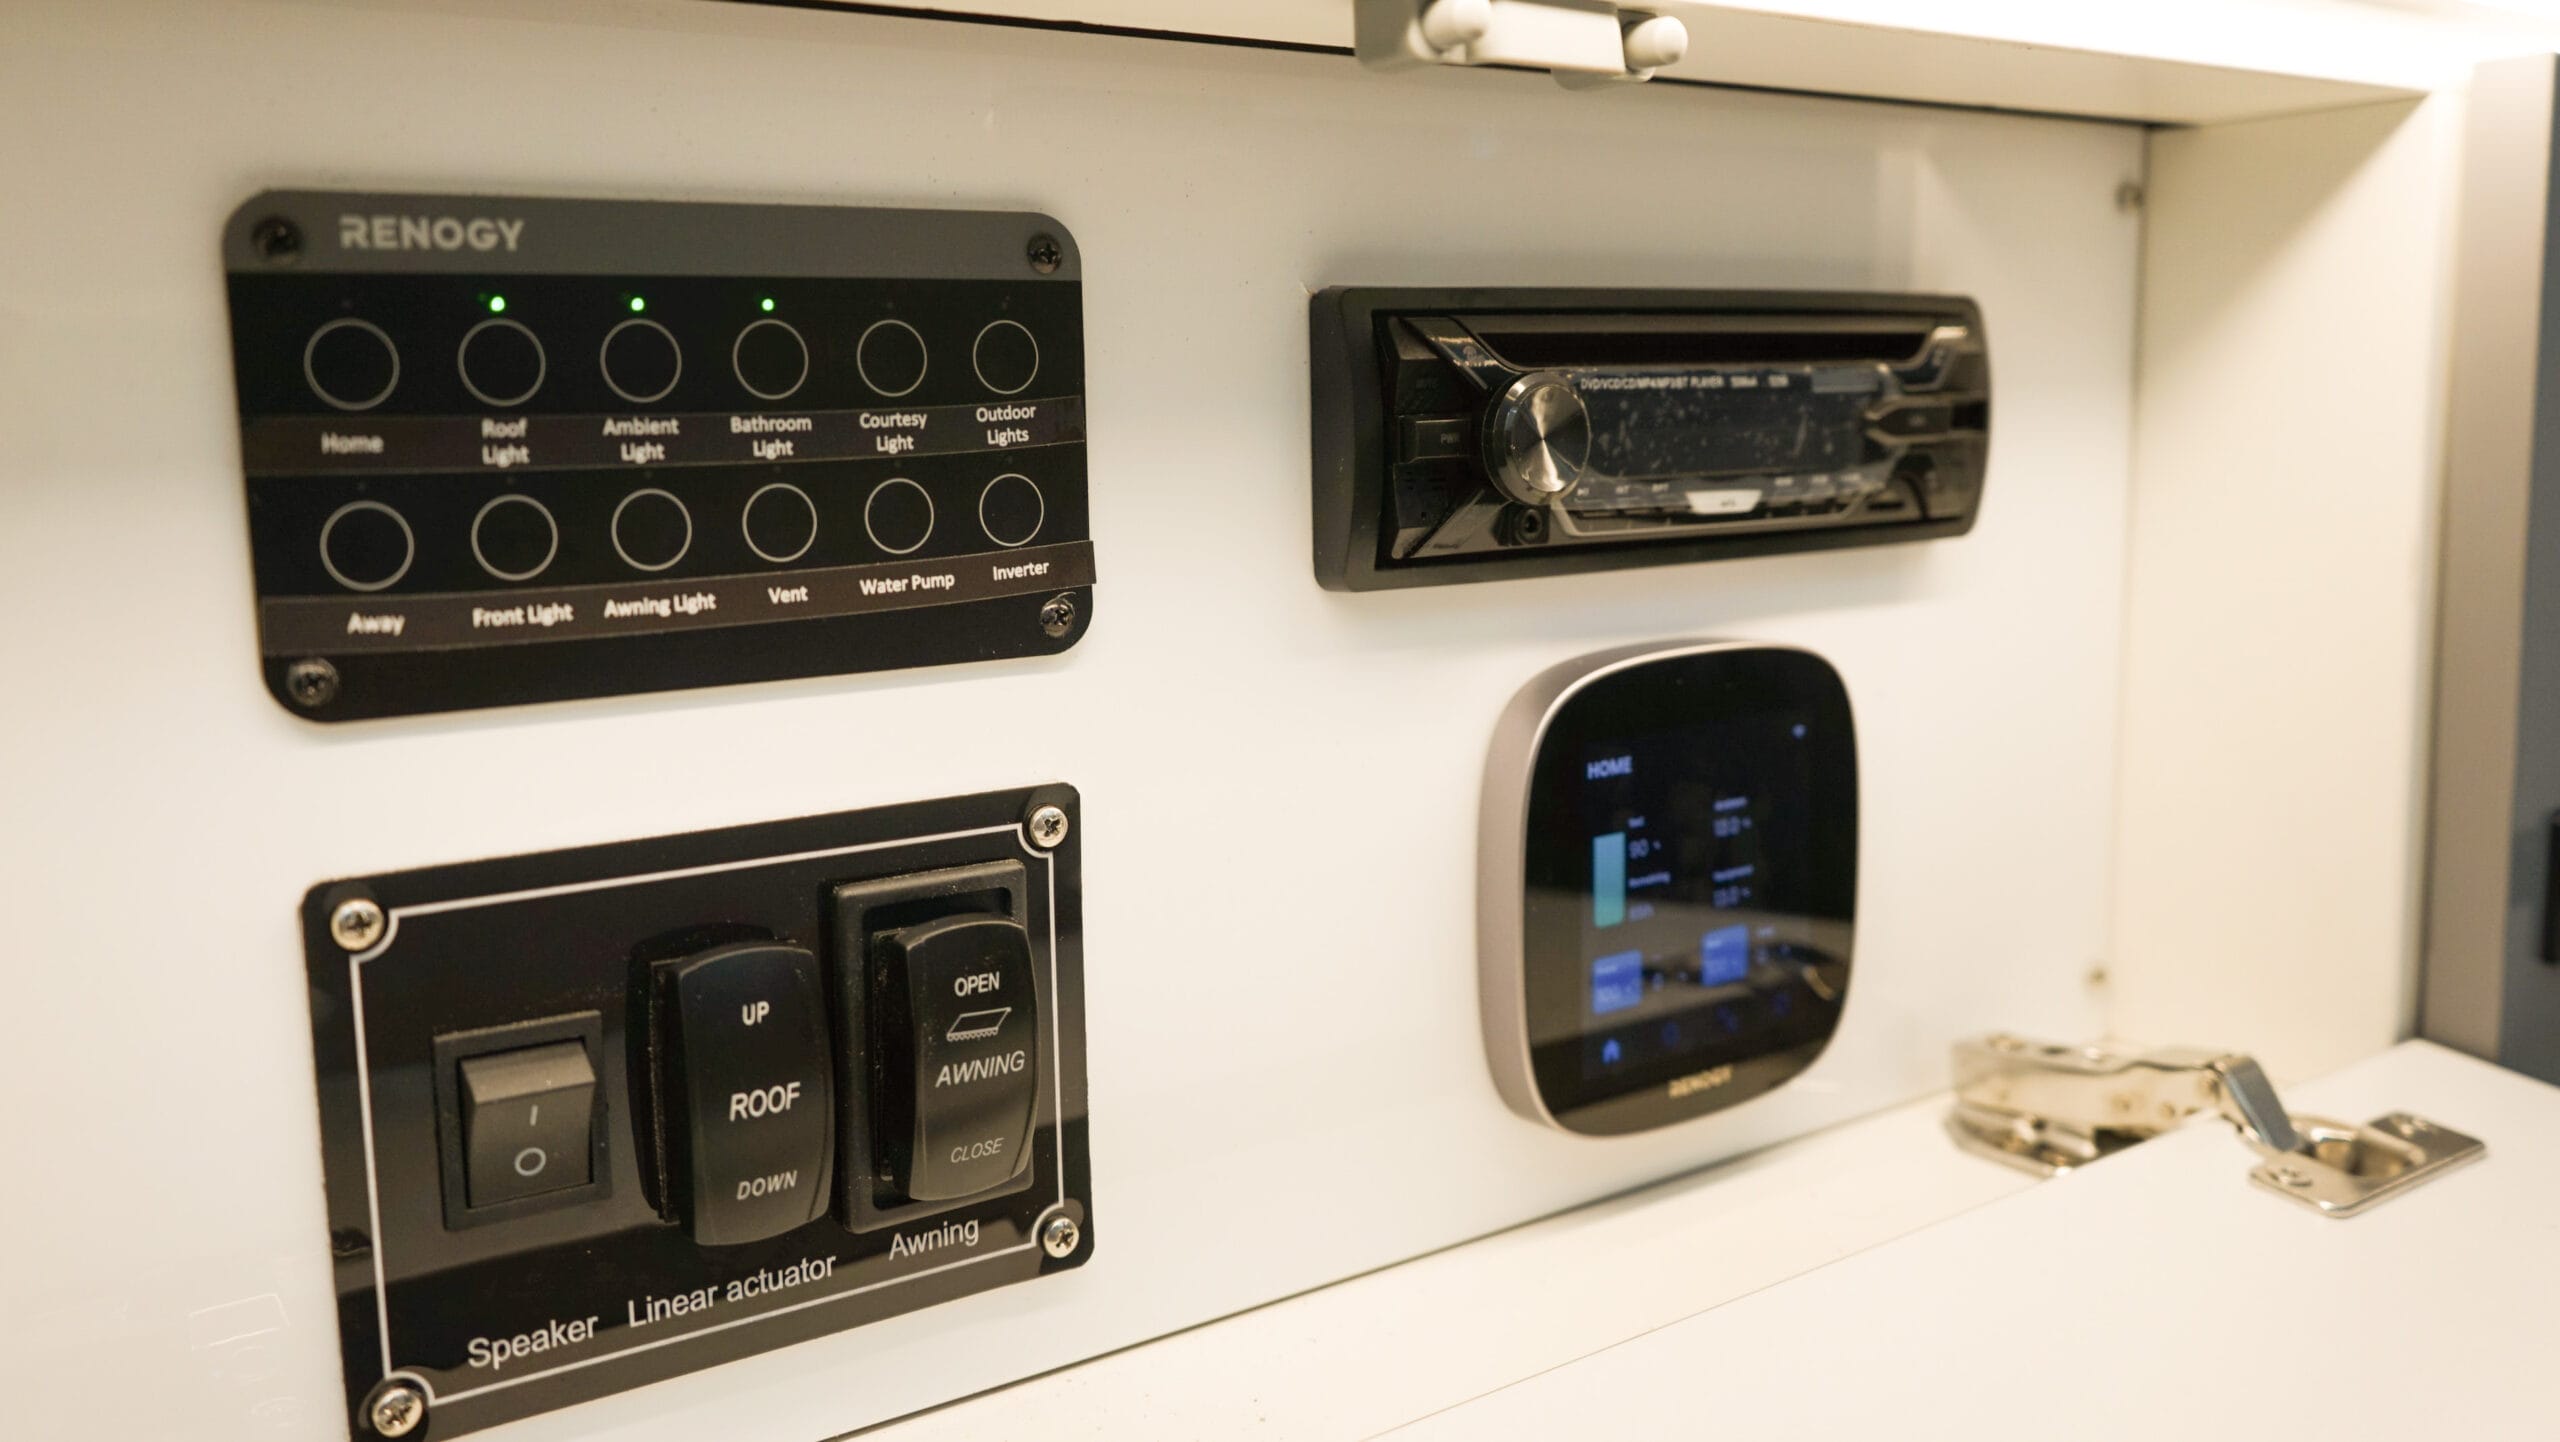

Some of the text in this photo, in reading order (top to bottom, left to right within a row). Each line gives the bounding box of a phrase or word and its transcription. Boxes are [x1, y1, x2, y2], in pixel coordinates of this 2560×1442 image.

[339, 214, 525, 252] RENOGY
[730, 415, 812, 435] Bathroom
[859, 411, 928, 432] Courtesy
[976, 404, 1037, 424] Outdoor
[481, 417, 529, 440] Roof
[602, 417, 680, 437] Ambient
[987, 428, 1030, 447] Lights
[321, 432, 385, 455] Home
[481, 443, 531, 468] Light
[620, 442, 666, 464] Light
[752, 438, 794, 460] Light
[876, 433, 915, 454] Light
[992, 559, 1050, 582] Inverter
[768, 585, 809, 605] Vent
[859, 571, 956, 597] Water Pump
[472, 602, 575, 628] Front Light
[604, 591, 717, 619] Awning Light
[347, 611, 406, 637] Away
[1586, 755, 1634, 780] HOME
[953, 970, 1001, 998] OPEN
[741, 1000, 770, 1026] UP
[934, 1048, 1027, 1090] AWNING
[728, 1080, 801, 1122] ROOF
[950, 1136, 1005, 1165] CLOSE
[735, 1169, 798, 1201] DOWN
[888, 1218, 981, 1261] Awning
[627, 1254, 837, 1328] Linear actuator
[466, 1314, 600, 1371] Speaker
